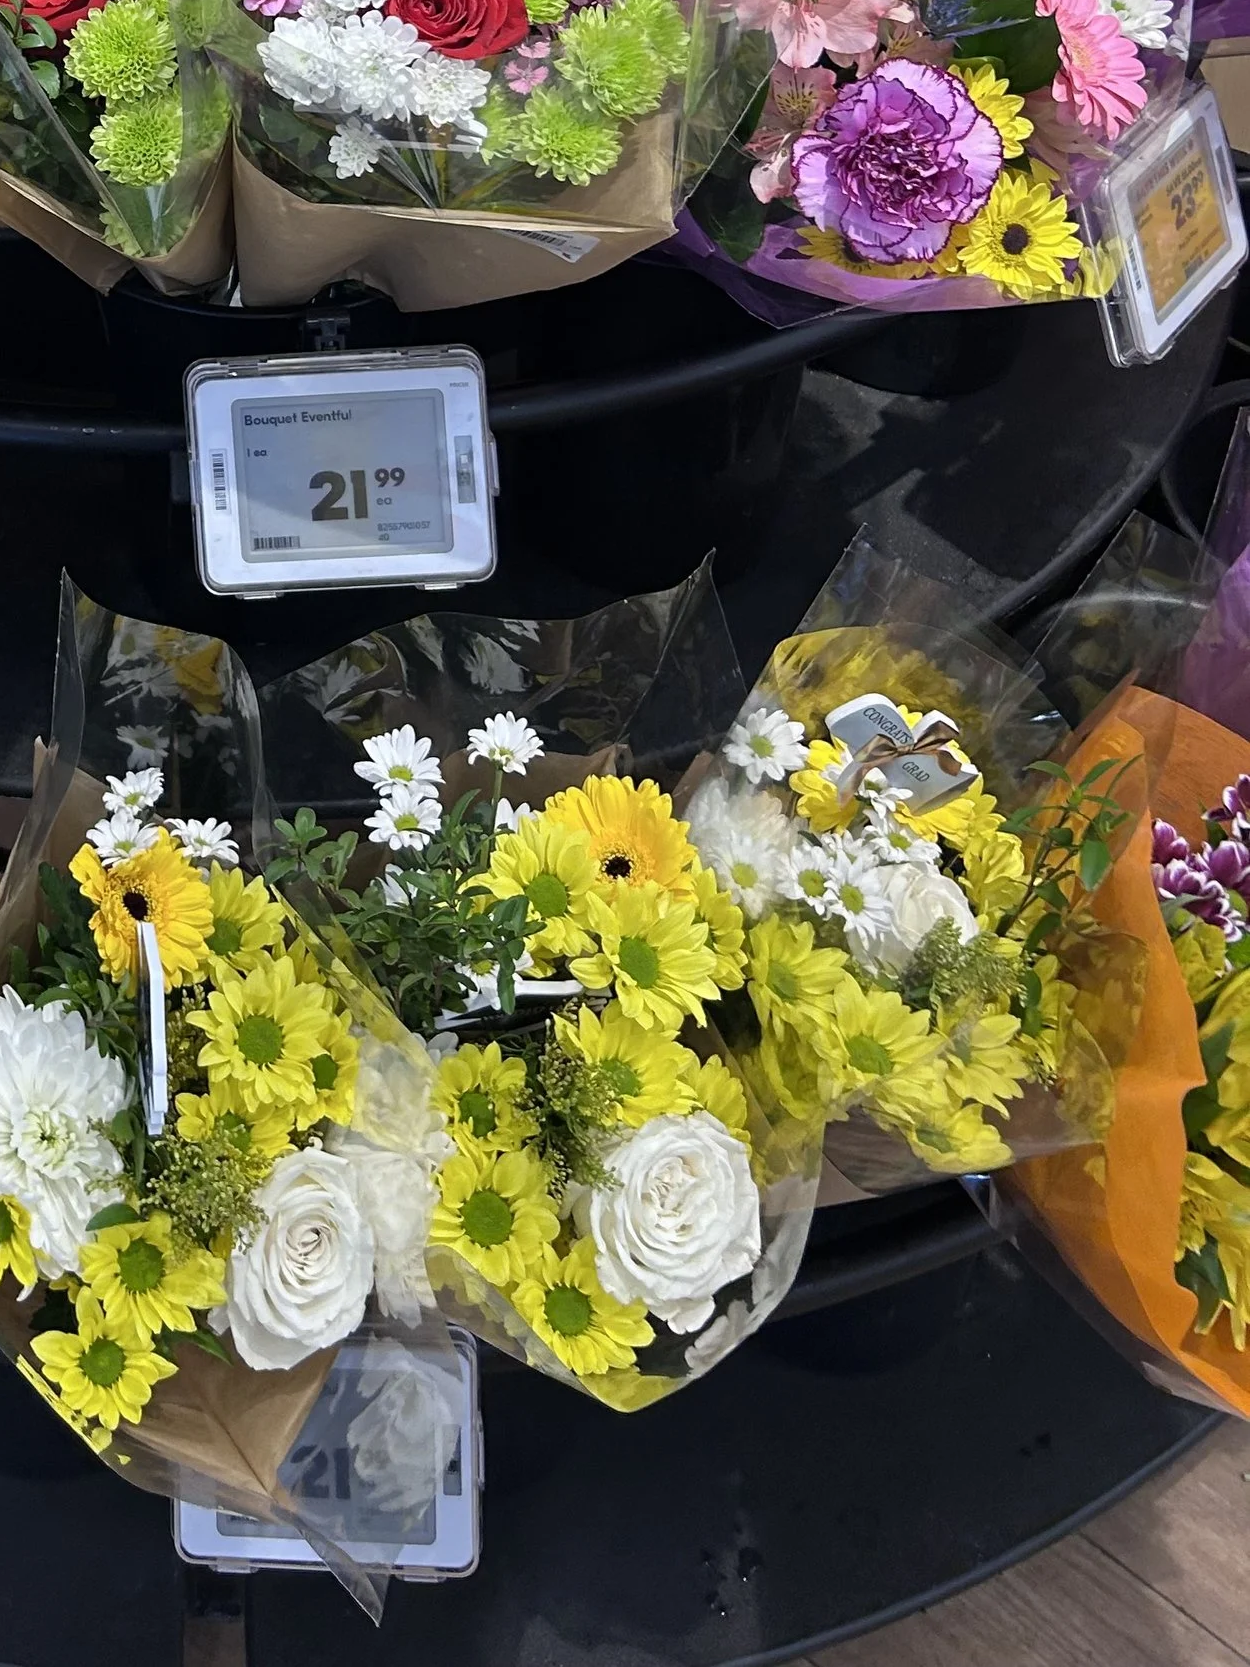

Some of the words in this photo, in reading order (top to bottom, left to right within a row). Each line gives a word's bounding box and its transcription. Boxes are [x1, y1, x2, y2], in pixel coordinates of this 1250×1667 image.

[1171, 183, 1196, 231] 23
[244, 412, 298, 428] Bouquet
[301, 408, 352, 423] Eventful
[253, 448, 268, 458] ea
[309, 469, 370, 522] 21
[374, 467, 406, 488] 99
[376, 497, 393, 506] ea
[863, 707, 912, 745] CONGRATS
[902, 761, 930, 783] GRAD
[290, 1444, 350, 1500] 21
